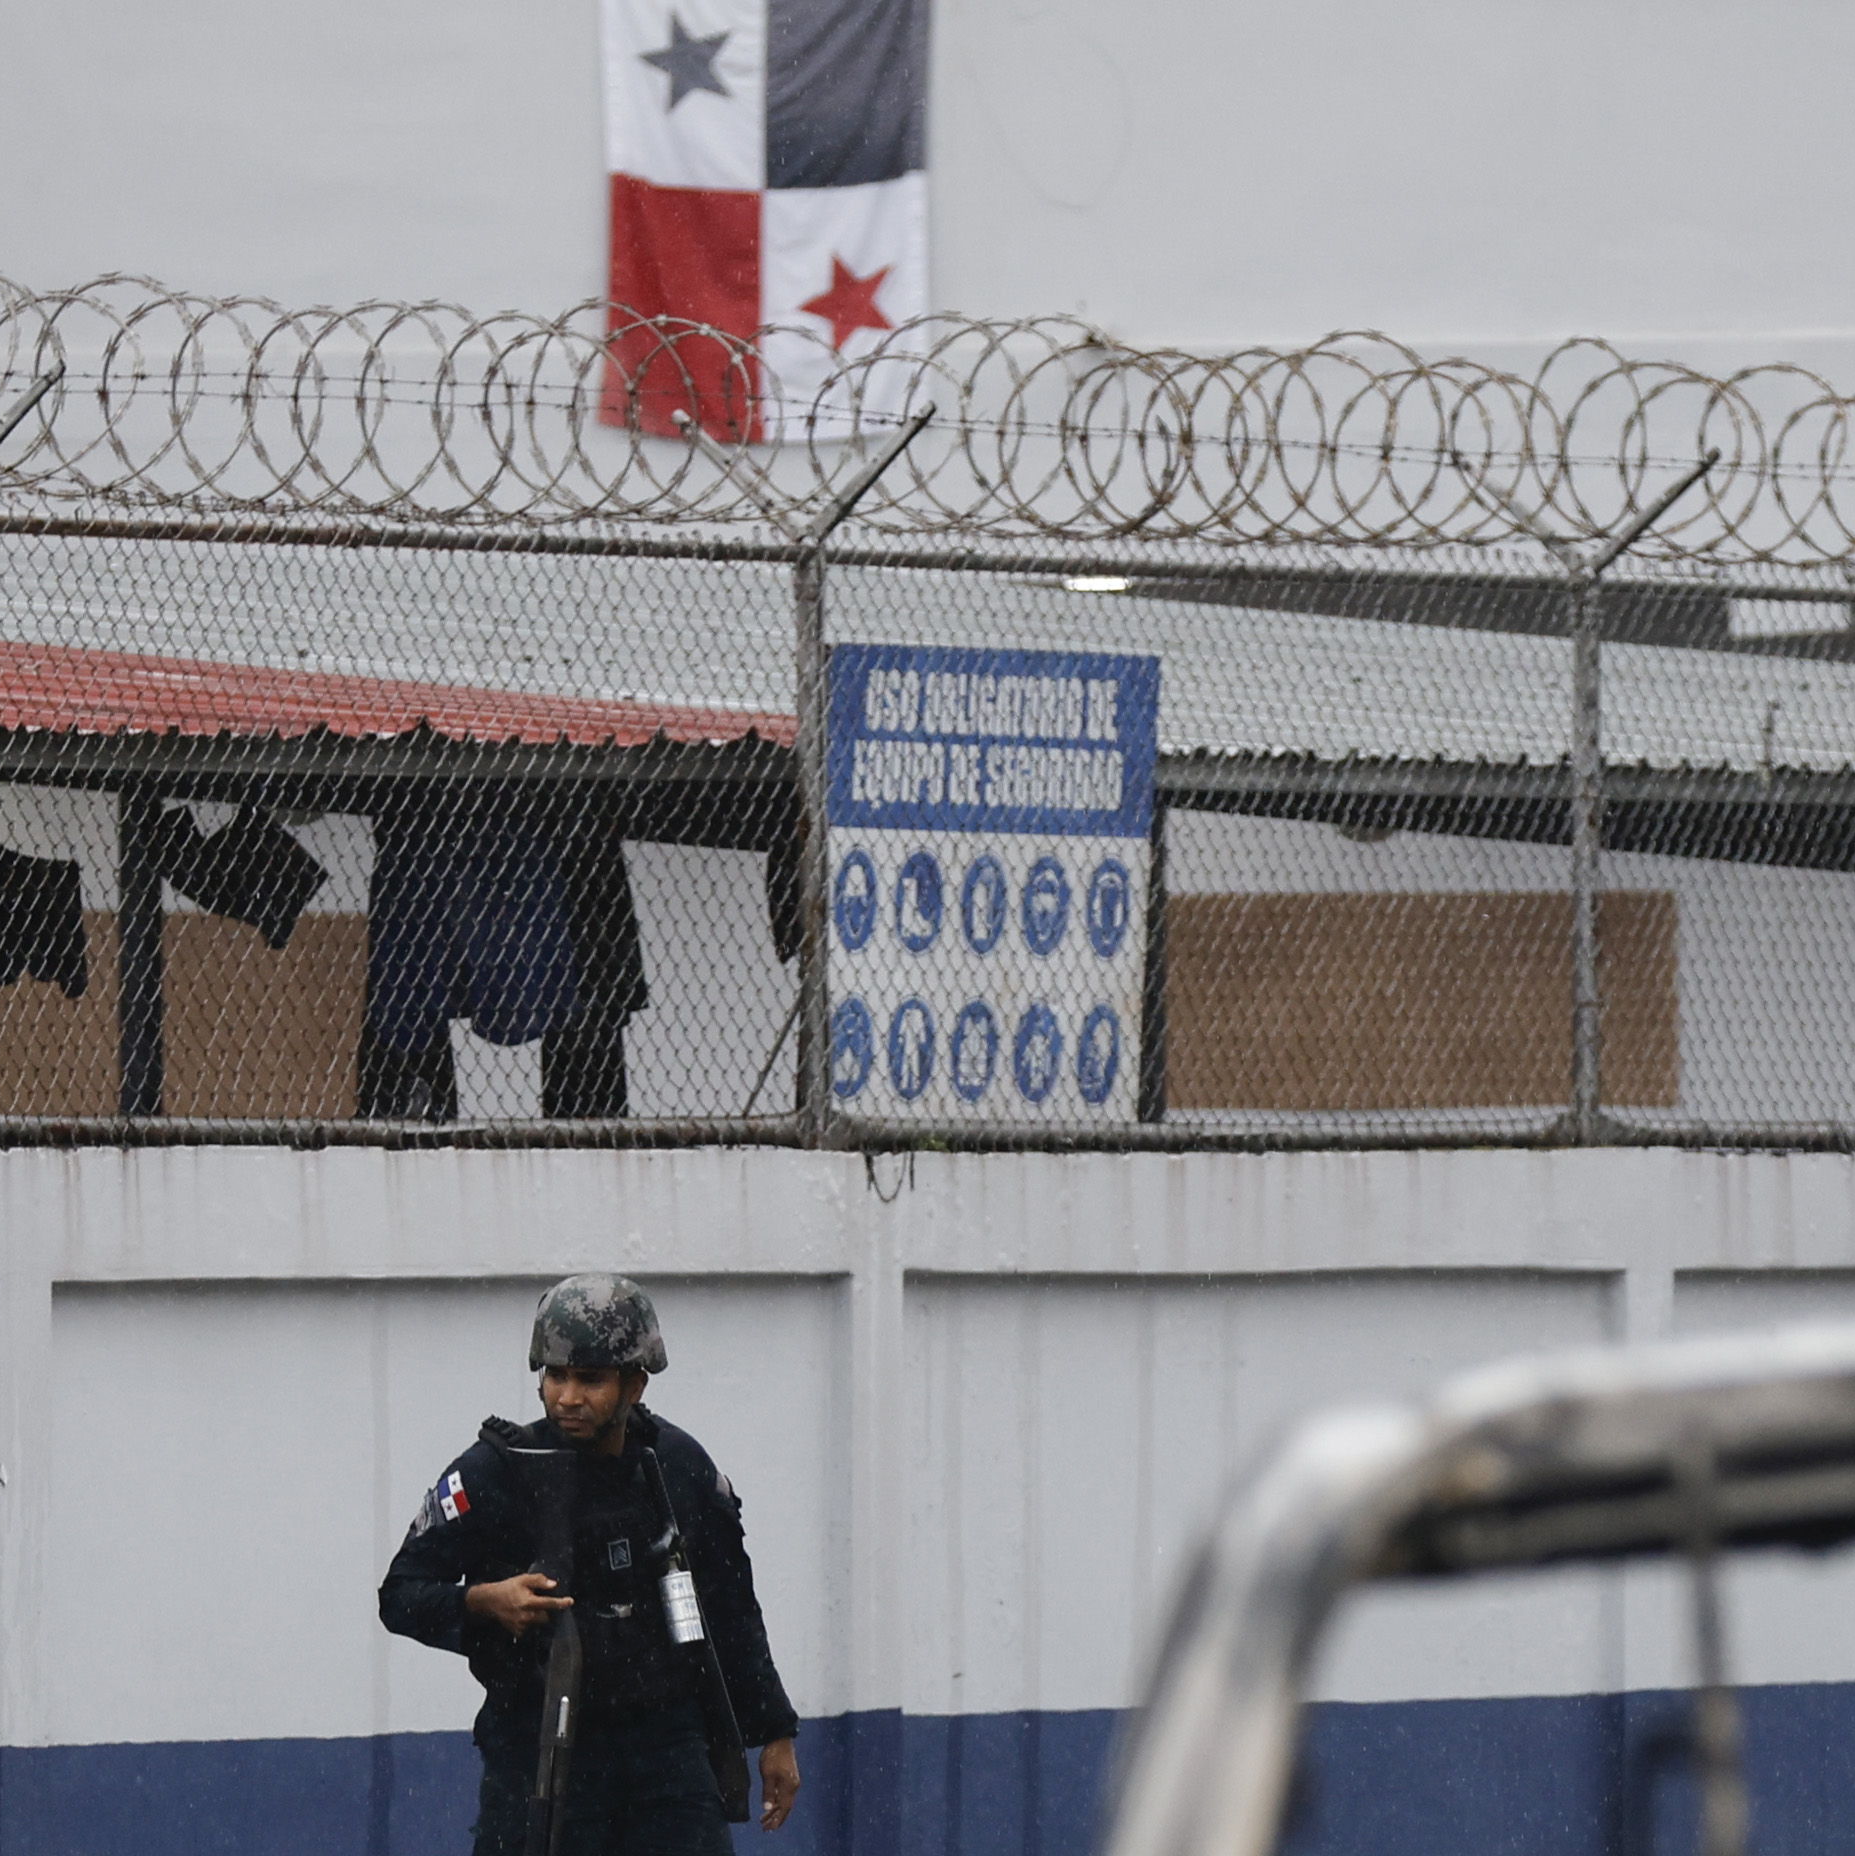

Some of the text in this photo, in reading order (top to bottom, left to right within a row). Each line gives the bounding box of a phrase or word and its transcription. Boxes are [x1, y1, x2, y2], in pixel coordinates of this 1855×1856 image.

[866, 669, 1118, 741] USO OBLIGATORIO DE
[852, 739, 1123, 811] EQUIPO DE SEGURIDAD
